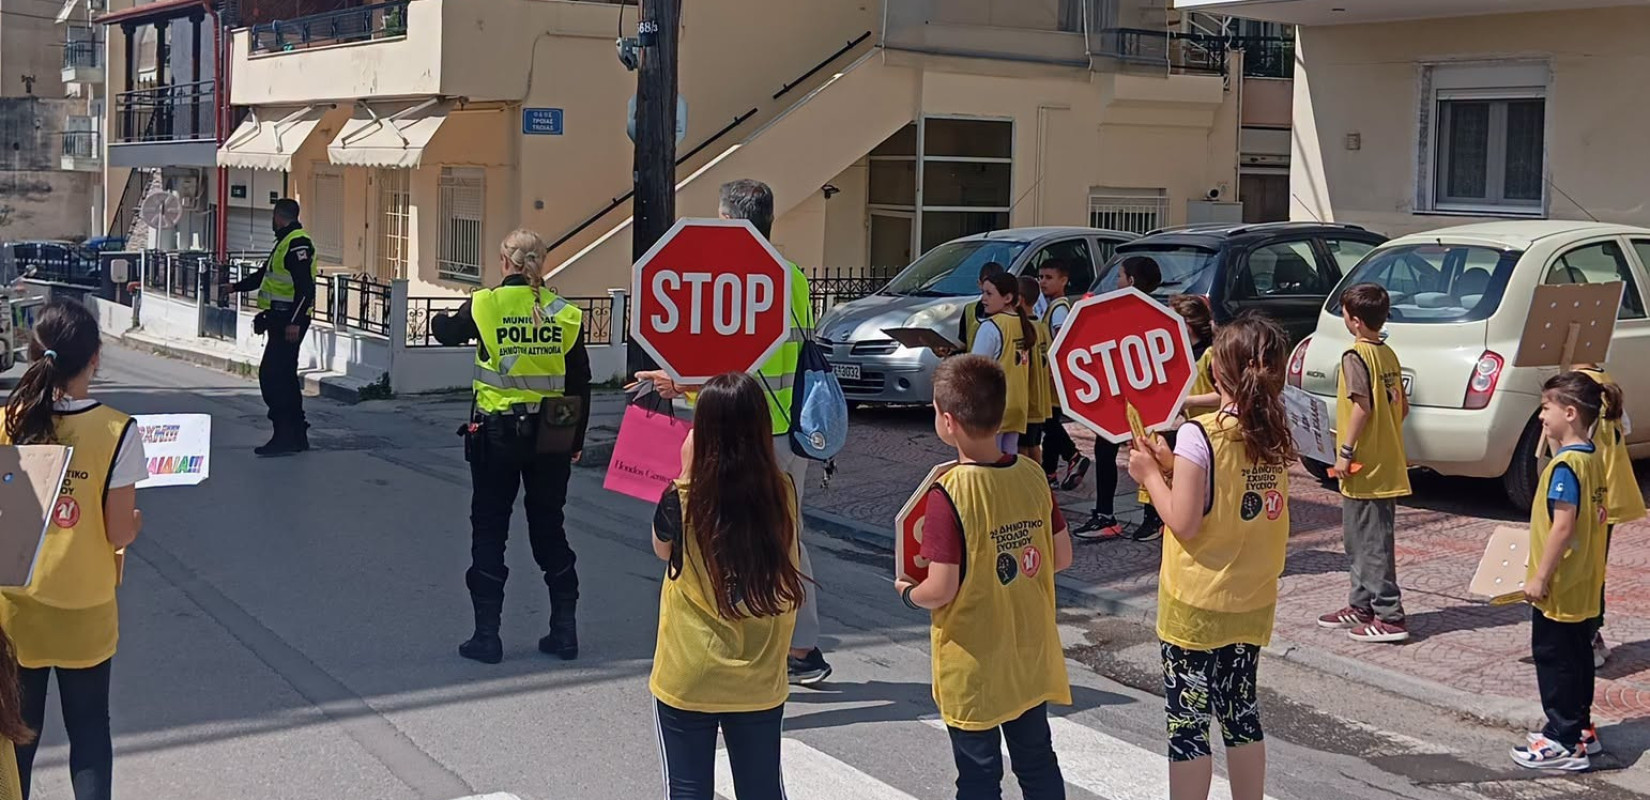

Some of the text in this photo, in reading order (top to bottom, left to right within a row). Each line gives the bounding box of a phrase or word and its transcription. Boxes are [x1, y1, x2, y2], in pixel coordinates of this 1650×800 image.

[651, 269, 774, 336] STOP
[502, 316, 556, 324] MUNICAL
[496, 325, 563, 345] POLICE
[1066, 327, 1175, 404] STOP
[614, 459, 644, 476] Hondos
